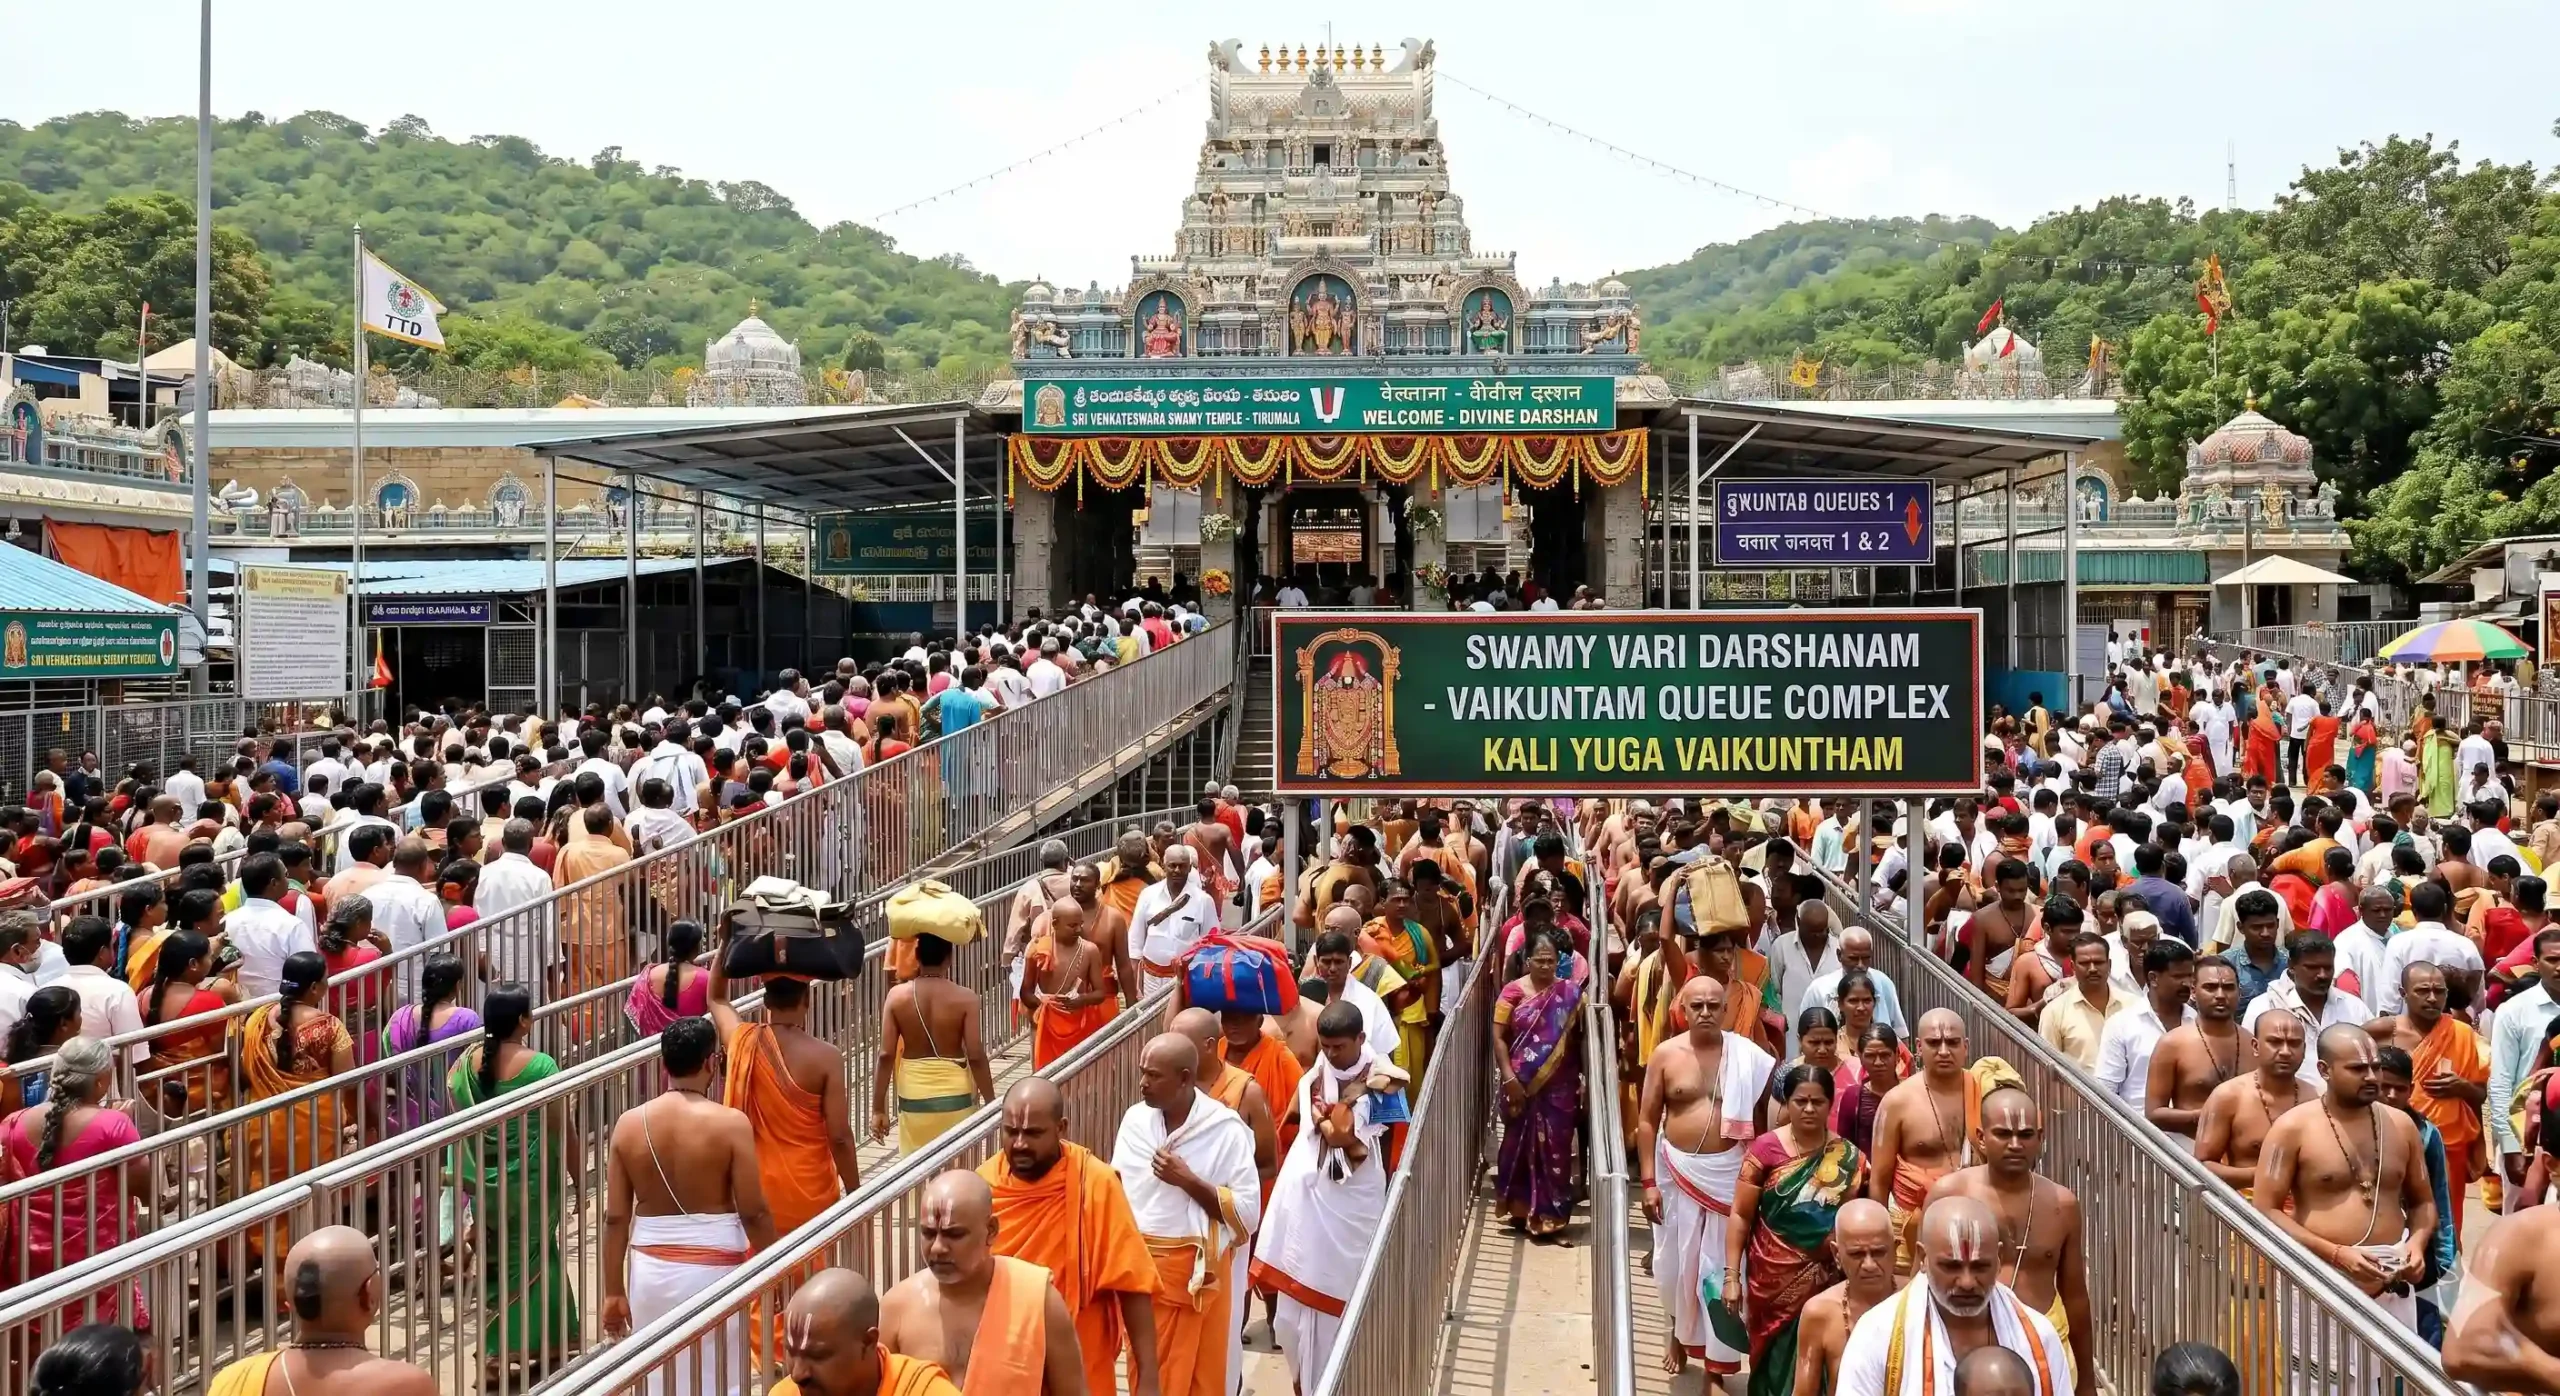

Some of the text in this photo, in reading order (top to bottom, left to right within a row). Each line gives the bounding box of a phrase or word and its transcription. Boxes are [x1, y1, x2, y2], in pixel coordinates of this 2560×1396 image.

[385, 314, 422, 336] TTD
[1072, 412, 1088, 426] SRI
[1091, 411, 1166, 426] VENKATESWARA
[1168, 411, 1203, 426] SWAMY
[1205, 411, 1243, 425] TEMPLE
[1253, 411, 1301, 425] TIRUMALA
[1363, 409, 1444, 426] WELCOME
[1459, 409, 1515, 425] DIVINE
[1520, 408, 1598, 424] DARSHAN
[1813, 492, 1881, 513] QUEUES
[1886, 492, 1895, 511] 1
[1841, 531, 1849, 551] 1
[1858, 531, 1873, 551] &
[1878, 532, 1890, 551] 2
[1466, 633, 1920, 670] SWAMY VARI DARSHANAM
[1447, 685, 1646, 721] VAIKUNTAM
[1658, 685, 1772, 723] QUEUE
[1784, 684, 1950, 720] COMPLEX
[1484, 736, 1903, 772] KALI YUGA VAIKUNTHAM
